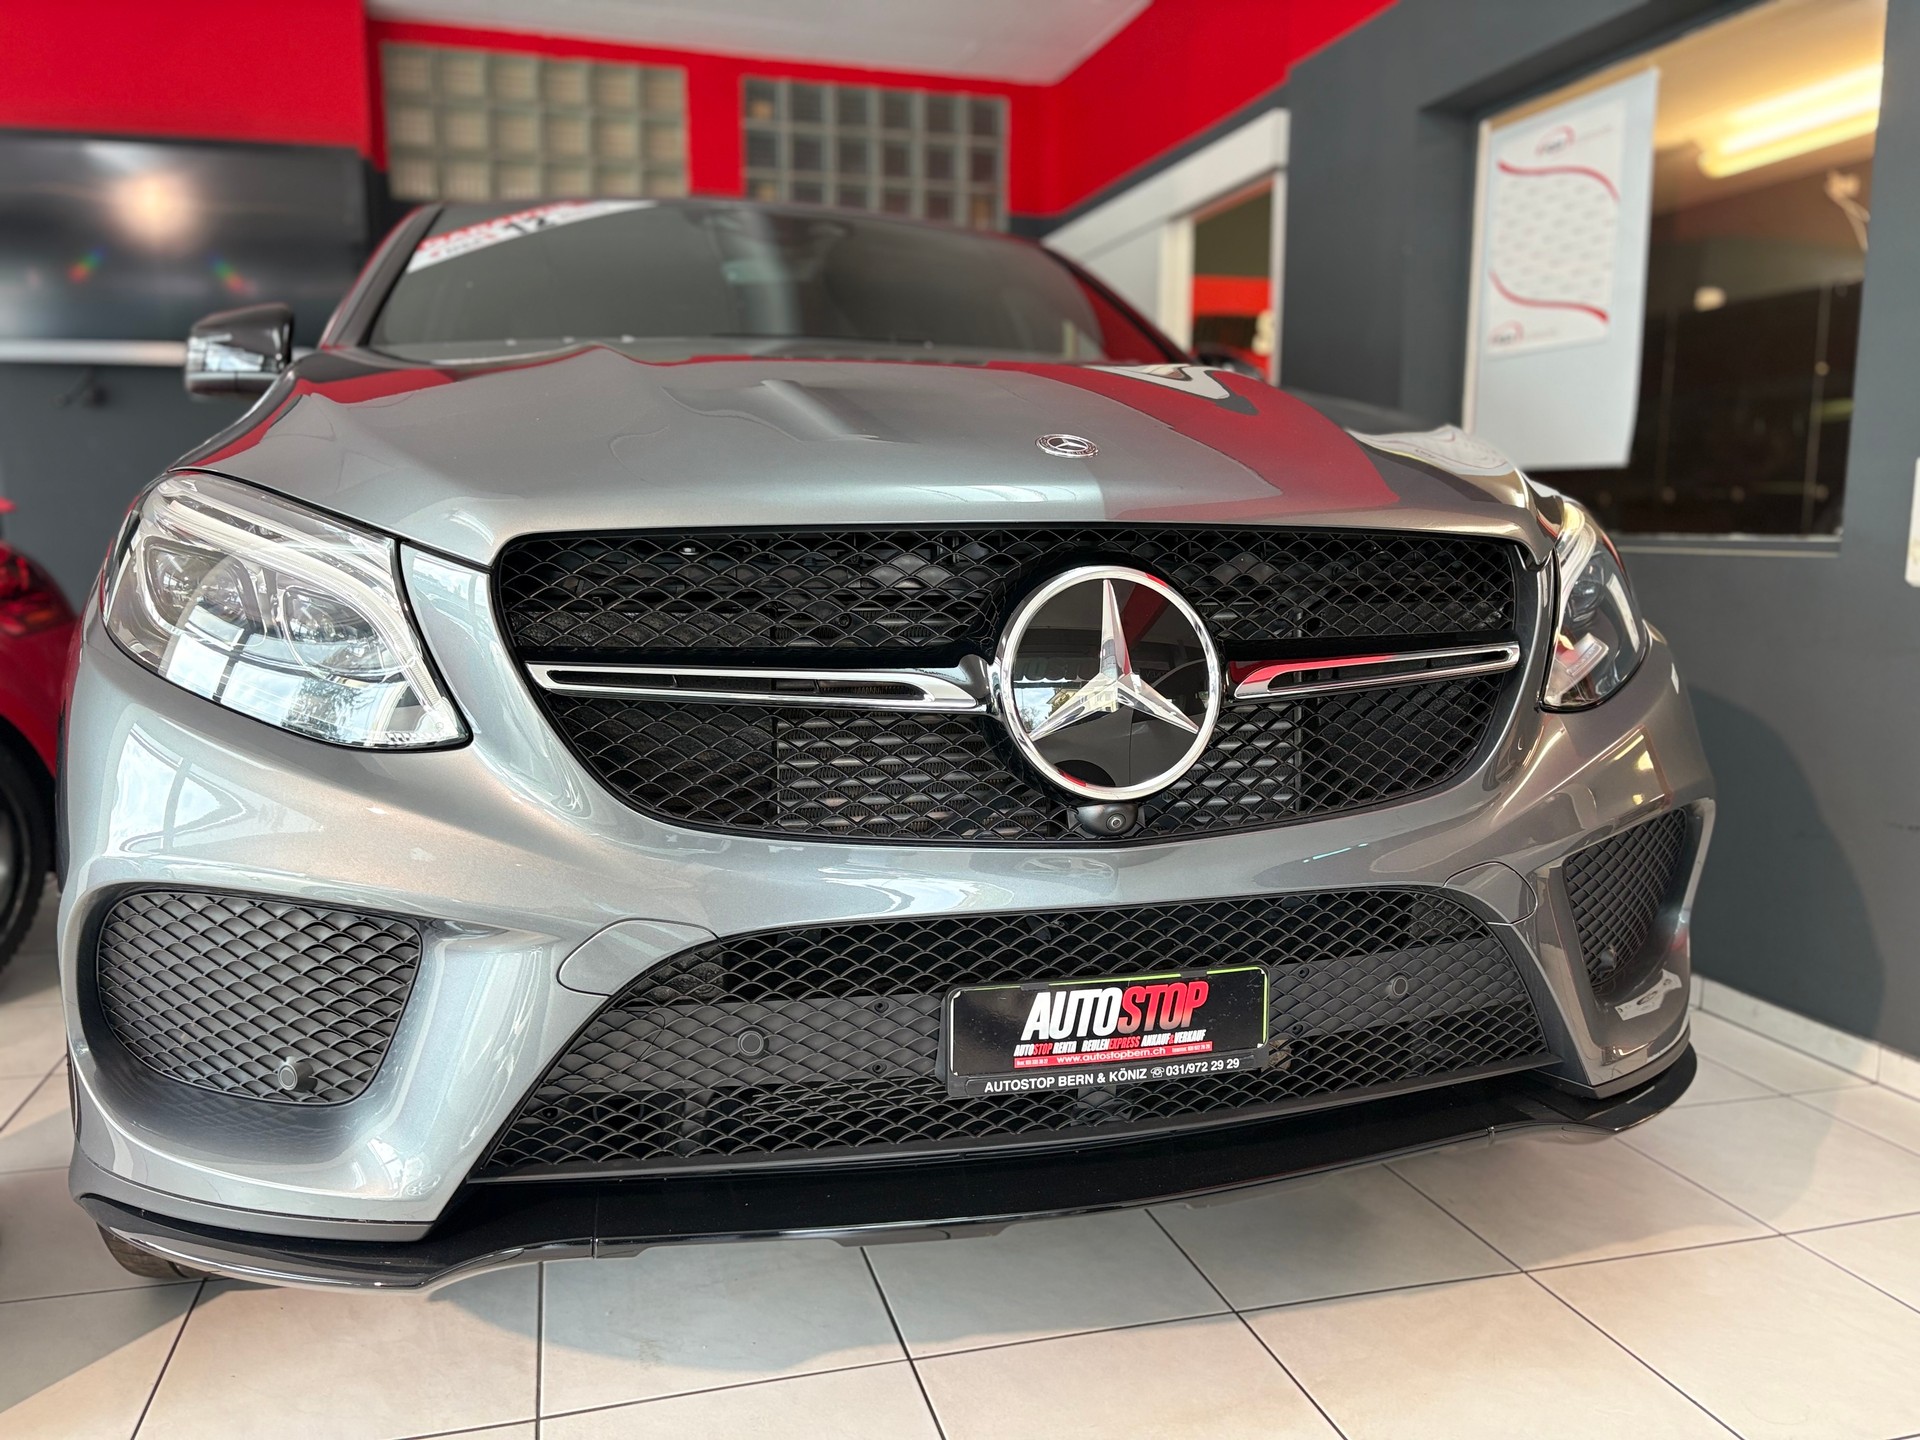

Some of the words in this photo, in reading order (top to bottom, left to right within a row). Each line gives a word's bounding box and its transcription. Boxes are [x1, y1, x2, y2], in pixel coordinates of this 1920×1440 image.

[1020, 981, 1209, 1040] AUTOSTOP
[1013, 1043, 1053, 1057] AUTOSTOP
[1057, 1047, 1166, 1063] www.autostopbern.ch
[984, 1076, 1055, 1093] AUTOSTOP
[1058, 1073, 1093, 1087] BERN
[1096, 1072, 1106, 1083] &
[1109, 1068, 1147, 1083] KÖNIZ
[1165, 1061, 1208, 1076] 031/972
[1210, 1059, 1224, 1071] 29
[1226, 1058, 1240, 1069] 29
